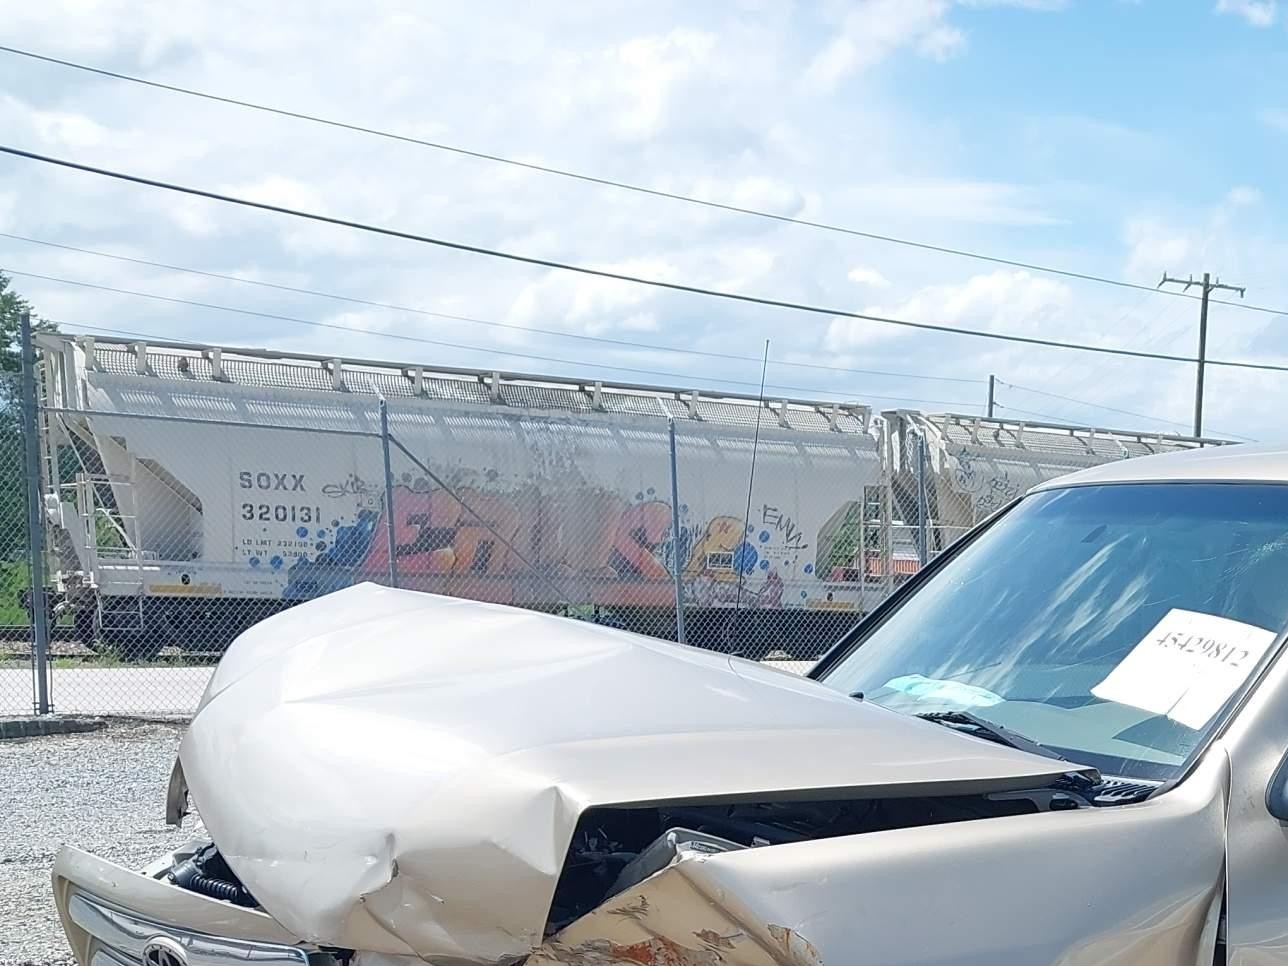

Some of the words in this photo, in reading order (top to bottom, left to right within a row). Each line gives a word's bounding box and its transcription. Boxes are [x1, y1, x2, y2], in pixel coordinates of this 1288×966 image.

[239, 471, 306, 492] SOXX
[241, 503, 321, 524] 320131
[256, 539, 272, 547] LMT
[1156, 630, 1250, 668] 45429812
